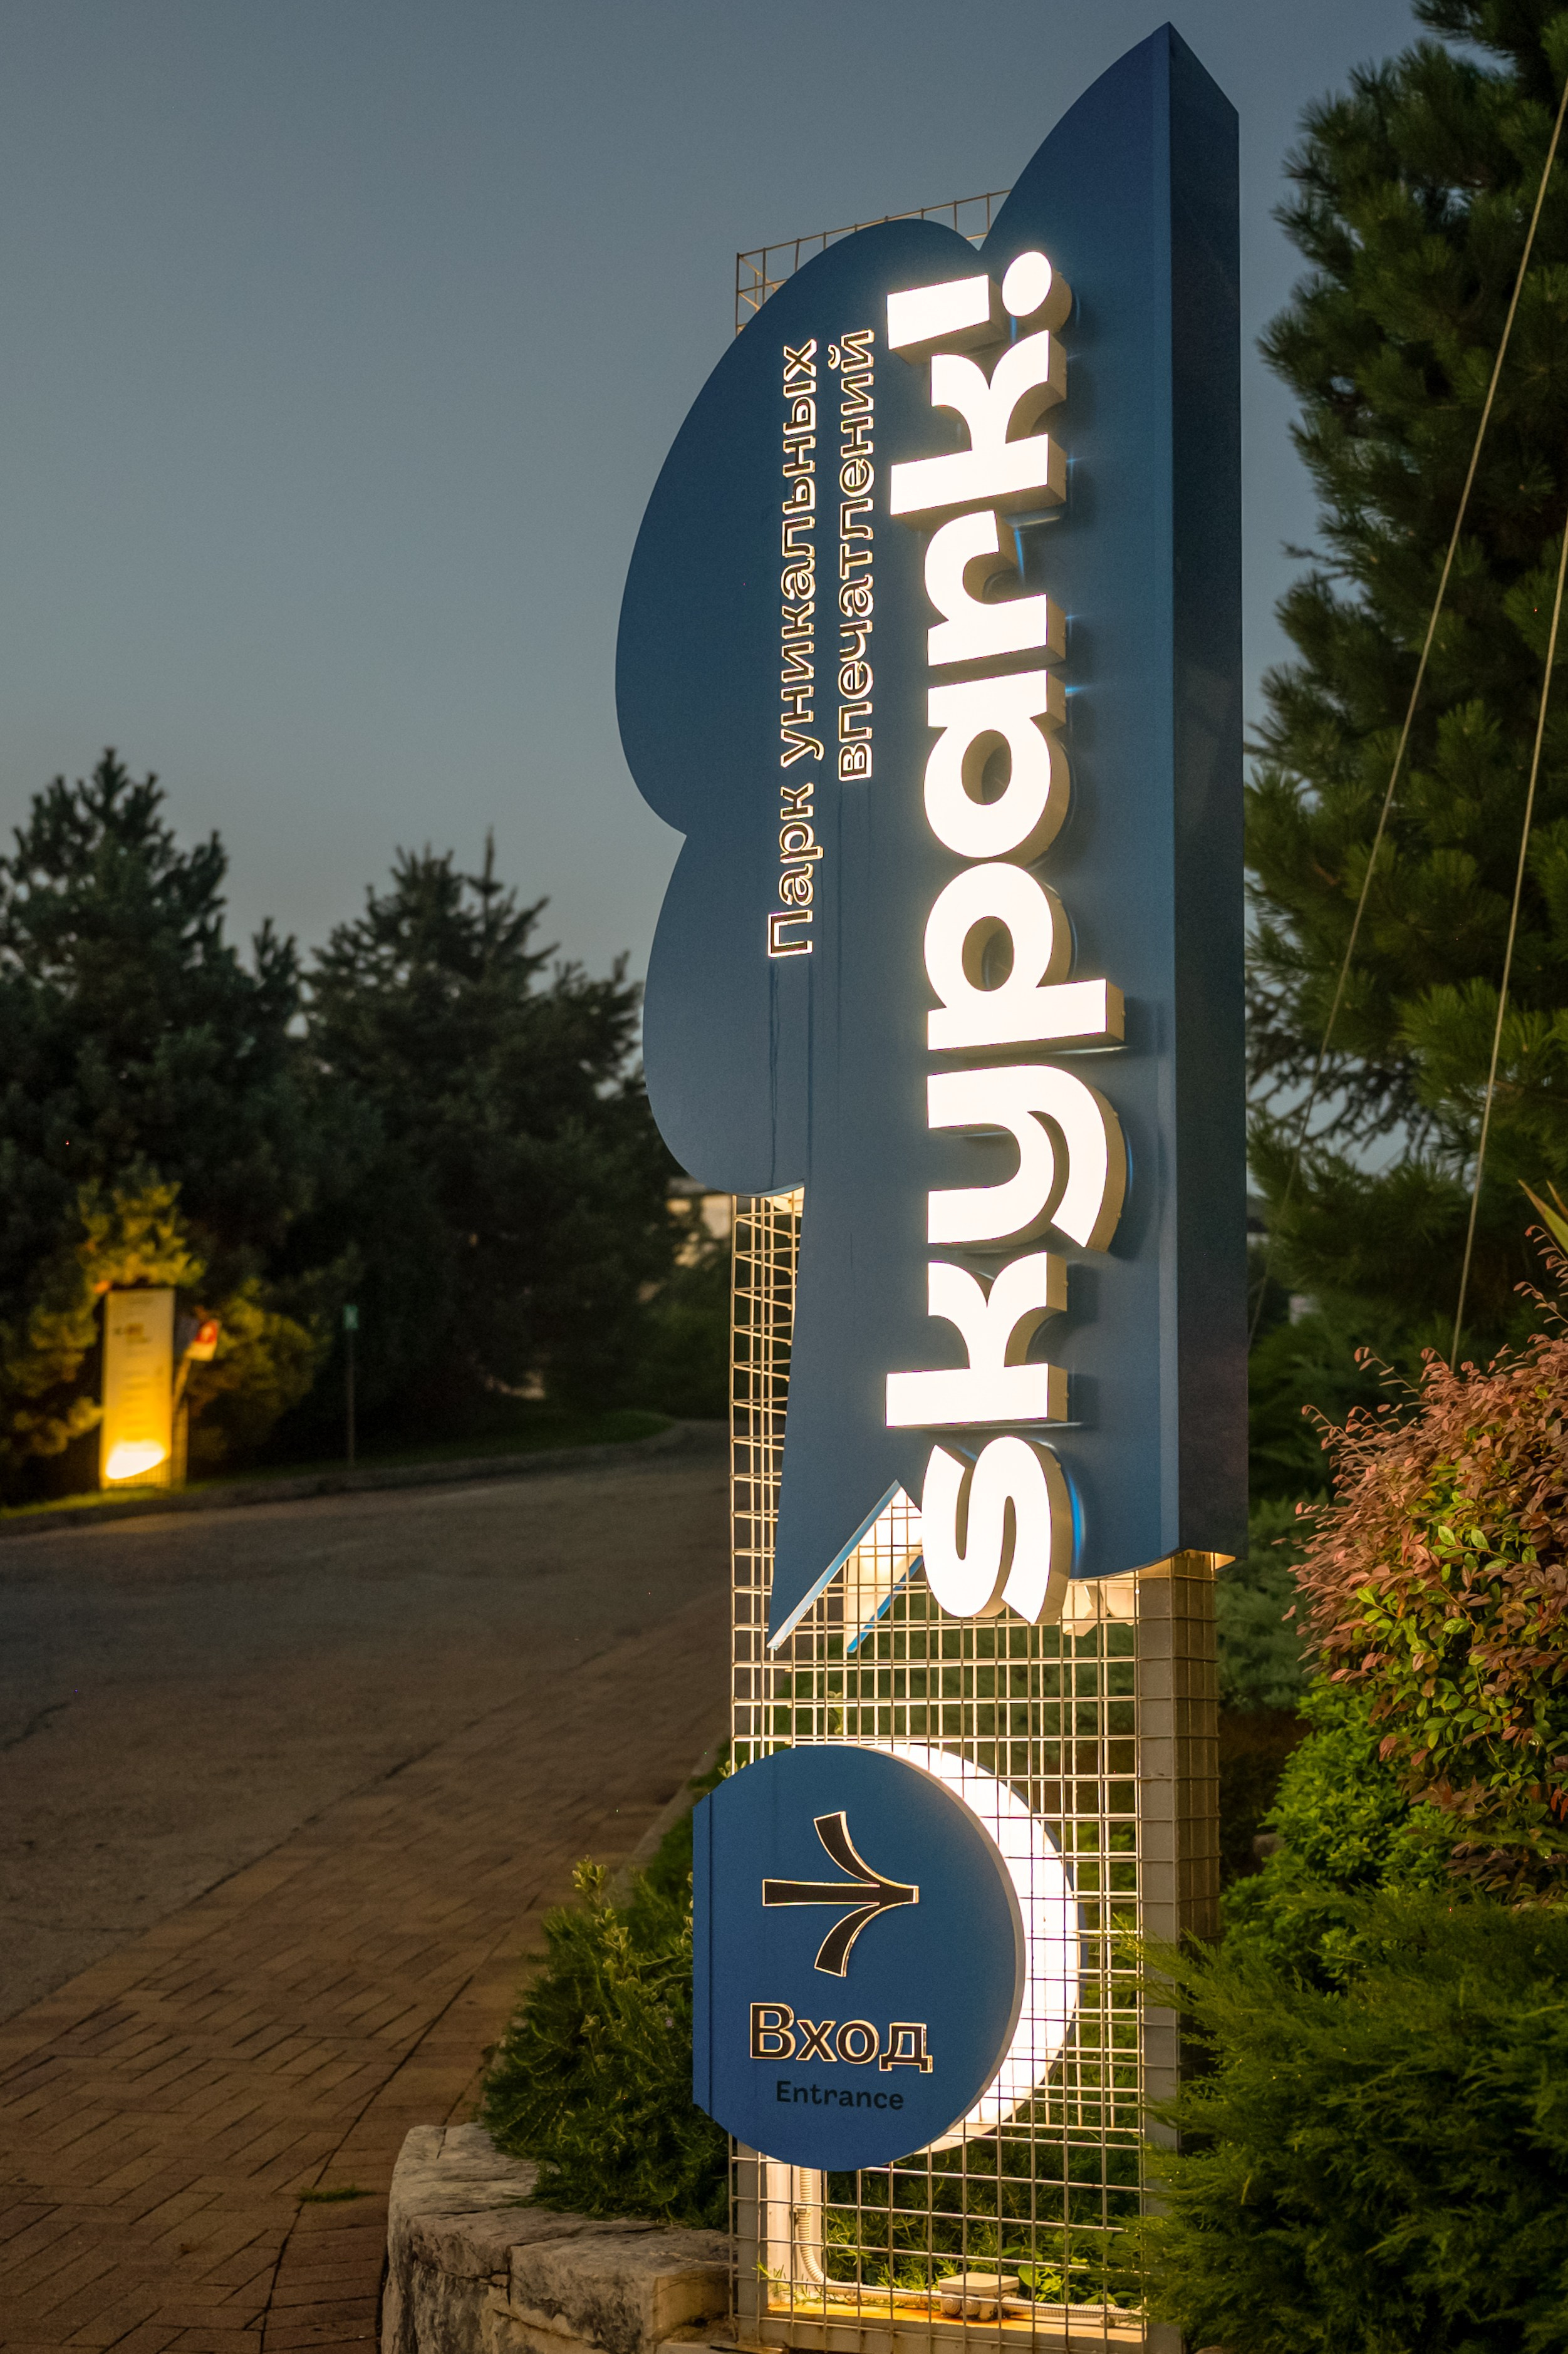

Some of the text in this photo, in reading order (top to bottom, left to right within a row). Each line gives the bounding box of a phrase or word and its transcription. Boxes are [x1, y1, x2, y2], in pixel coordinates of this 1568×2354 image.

[767, 338, 824, 958] Парк уникальных
[828, 329, 875, 781] впечатлений
[885, 251, 1110, 1625] skypark!
[750, 2003, 933, 2073] Вход
[776, 2080, 904, 2110] Entrance
